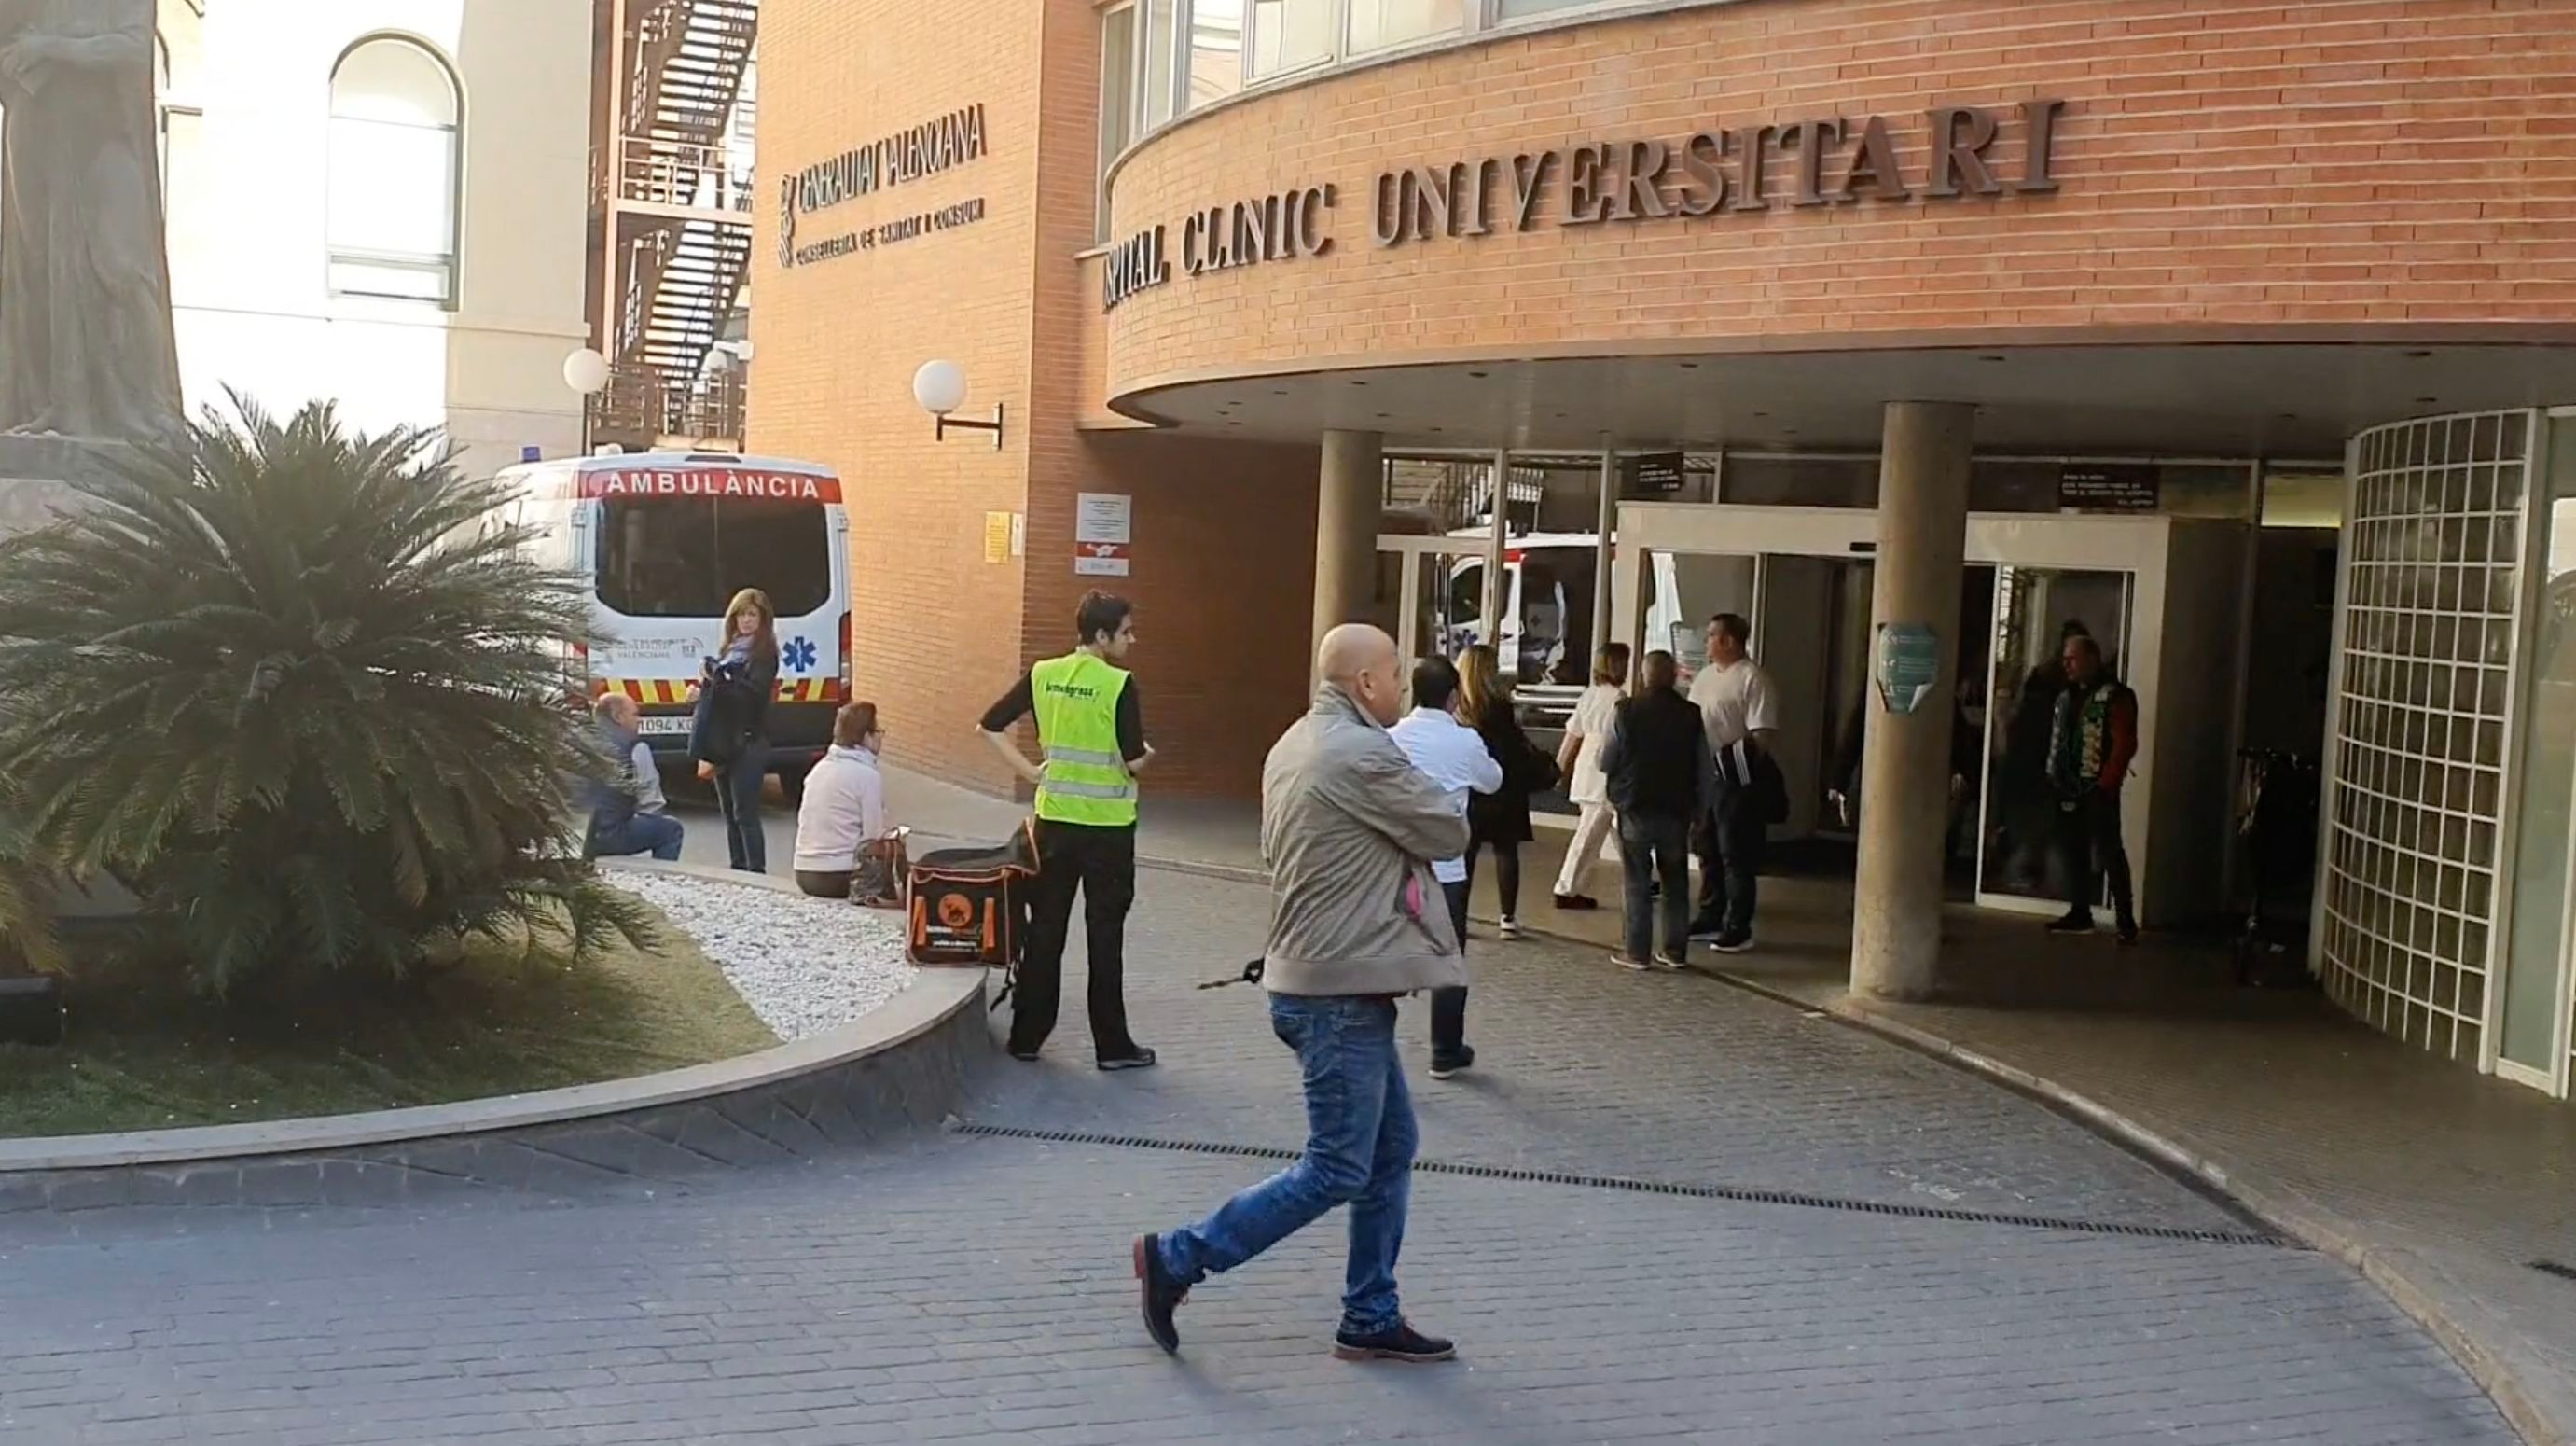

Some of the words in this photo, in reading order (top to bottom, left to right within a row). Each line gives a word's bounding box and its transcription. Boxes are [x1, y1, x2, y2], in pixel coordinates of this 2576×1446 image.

[1181, 183, 1336, 277] CLINIC
[1371, 100, 2064, 248] UNIVERSITARI
[607, 471, 820, 498] AMBULÀNCIA
